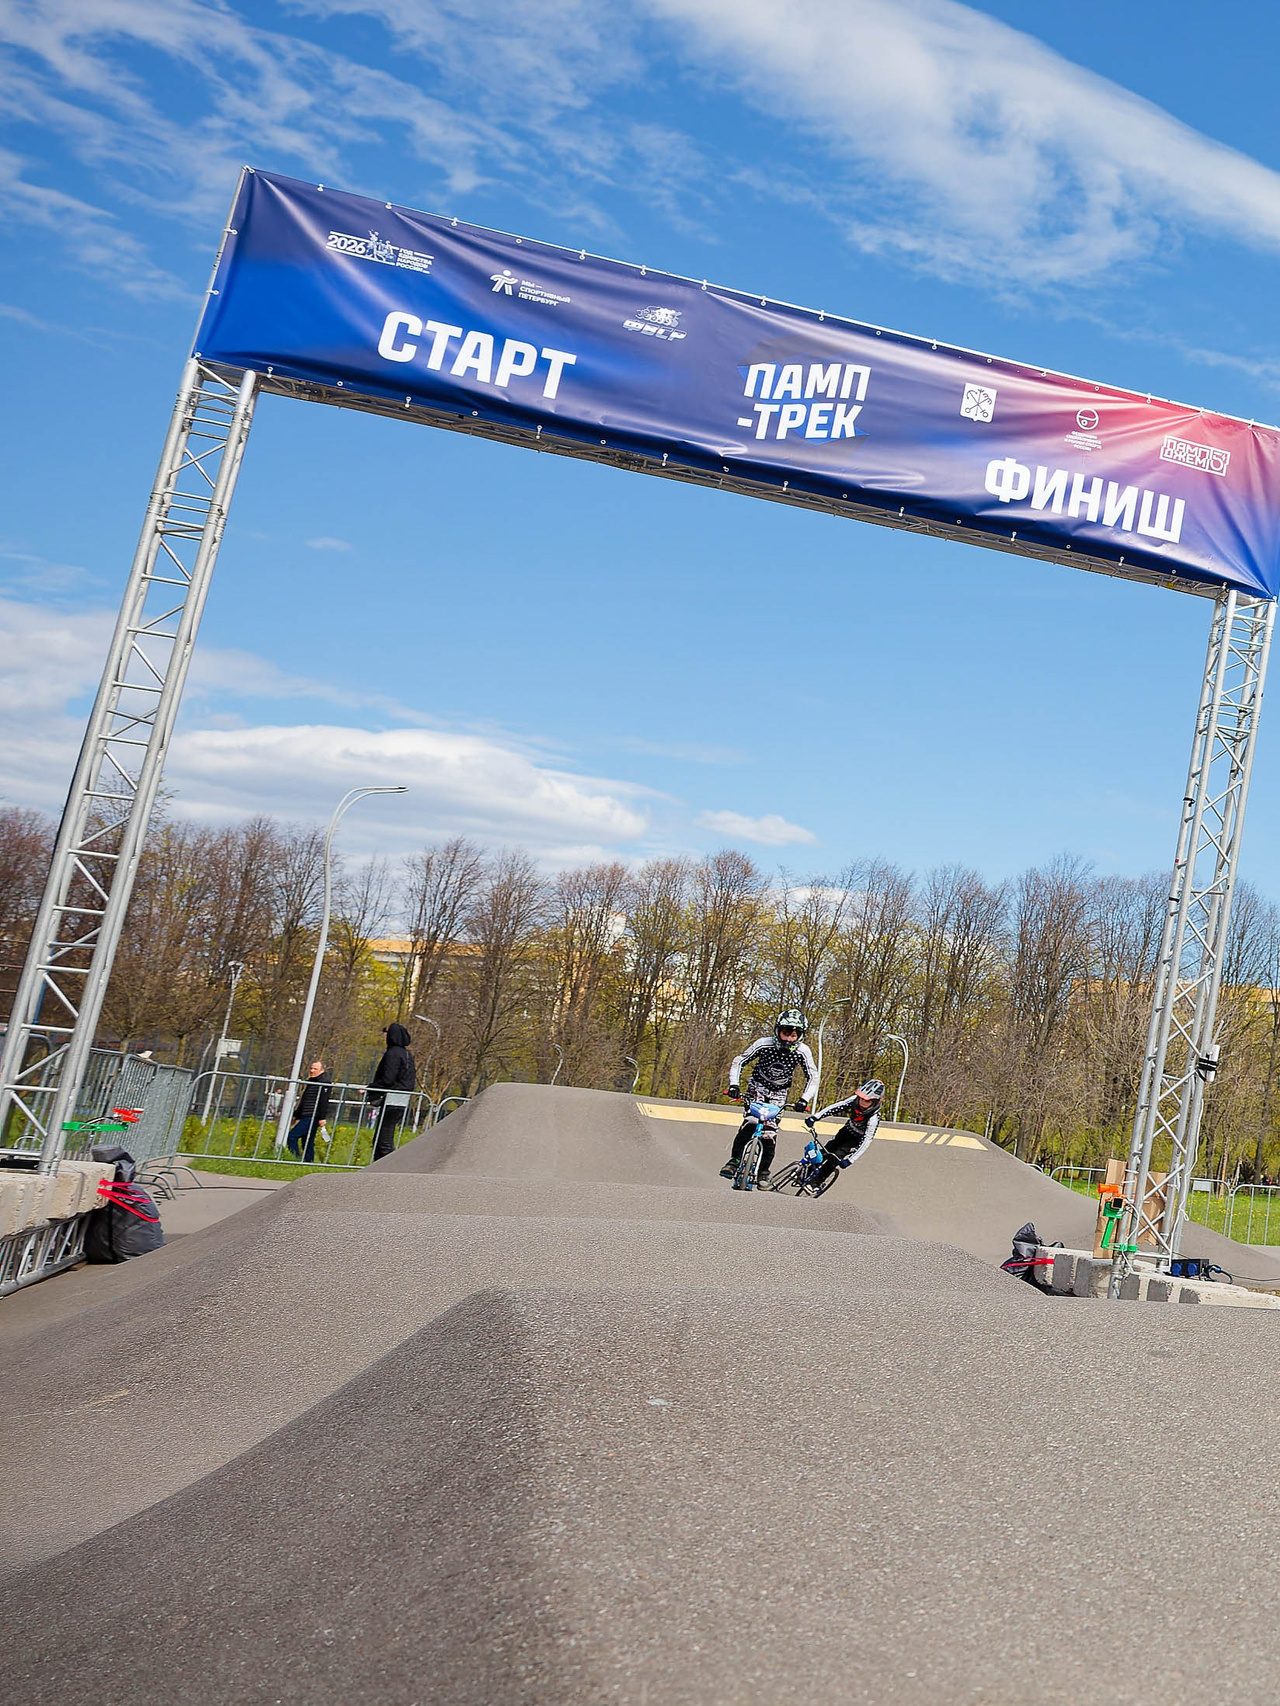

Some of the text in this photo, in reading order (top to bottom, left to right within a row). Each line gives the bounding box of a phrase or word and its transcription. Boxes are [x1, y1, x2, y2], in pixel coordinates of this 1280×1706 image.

[326, 234, 366, 255] 2026
[521, 280, 534, 288] МЫ
[518, 292, 560, 306] ПЕТЕРБУРГ
[519, 286, 570, 304] СПОРТИВНЫЙ
[377, 311, 577, 399] СТАРТ
[743, 363, 872, 402] ПАМП
[737, 402, 863, 440] -ТРЕК
[1163, 449, 1207, 468] ДЖЕМ
[1166, 439, 1210, 460] ПАМП
[984, 457, 1186, 544] ФИНИШ
